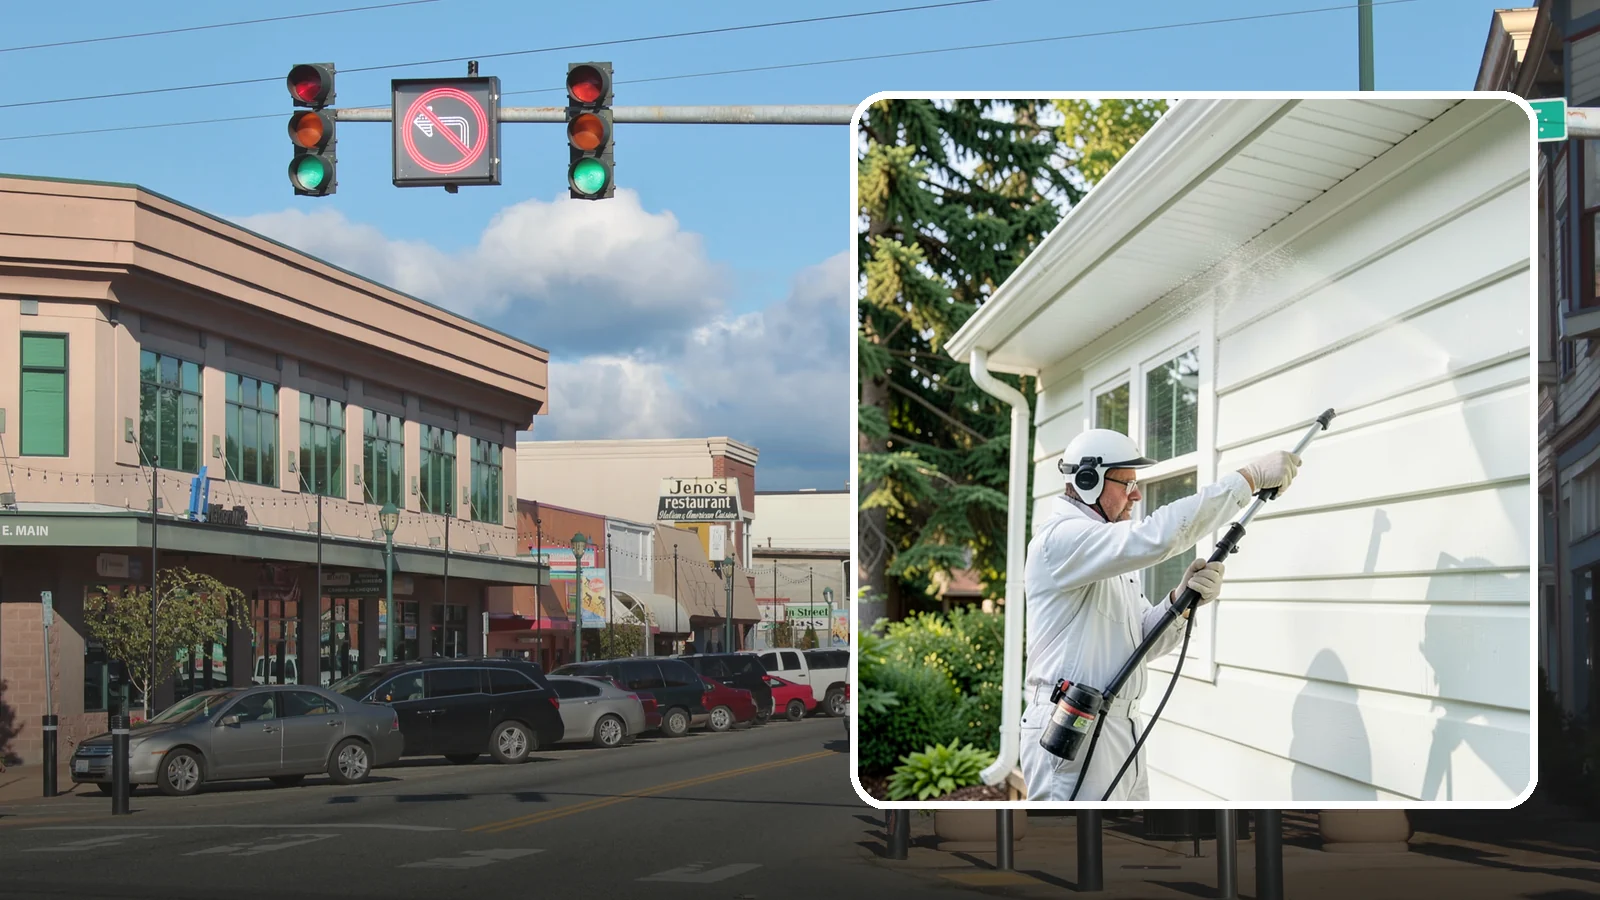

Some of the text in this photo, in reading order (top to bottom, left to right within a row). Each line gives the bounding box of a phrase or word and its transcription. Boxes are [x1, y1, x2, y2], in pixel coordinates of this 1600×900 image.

[669, 480, 728, 495] Jeno's
[665, 497, 731, 509] restaurant
[2, 525, 49, 536] E. MAIN
[797, 608, 828, 616] Street
[790, 619, 824, 627] lass
